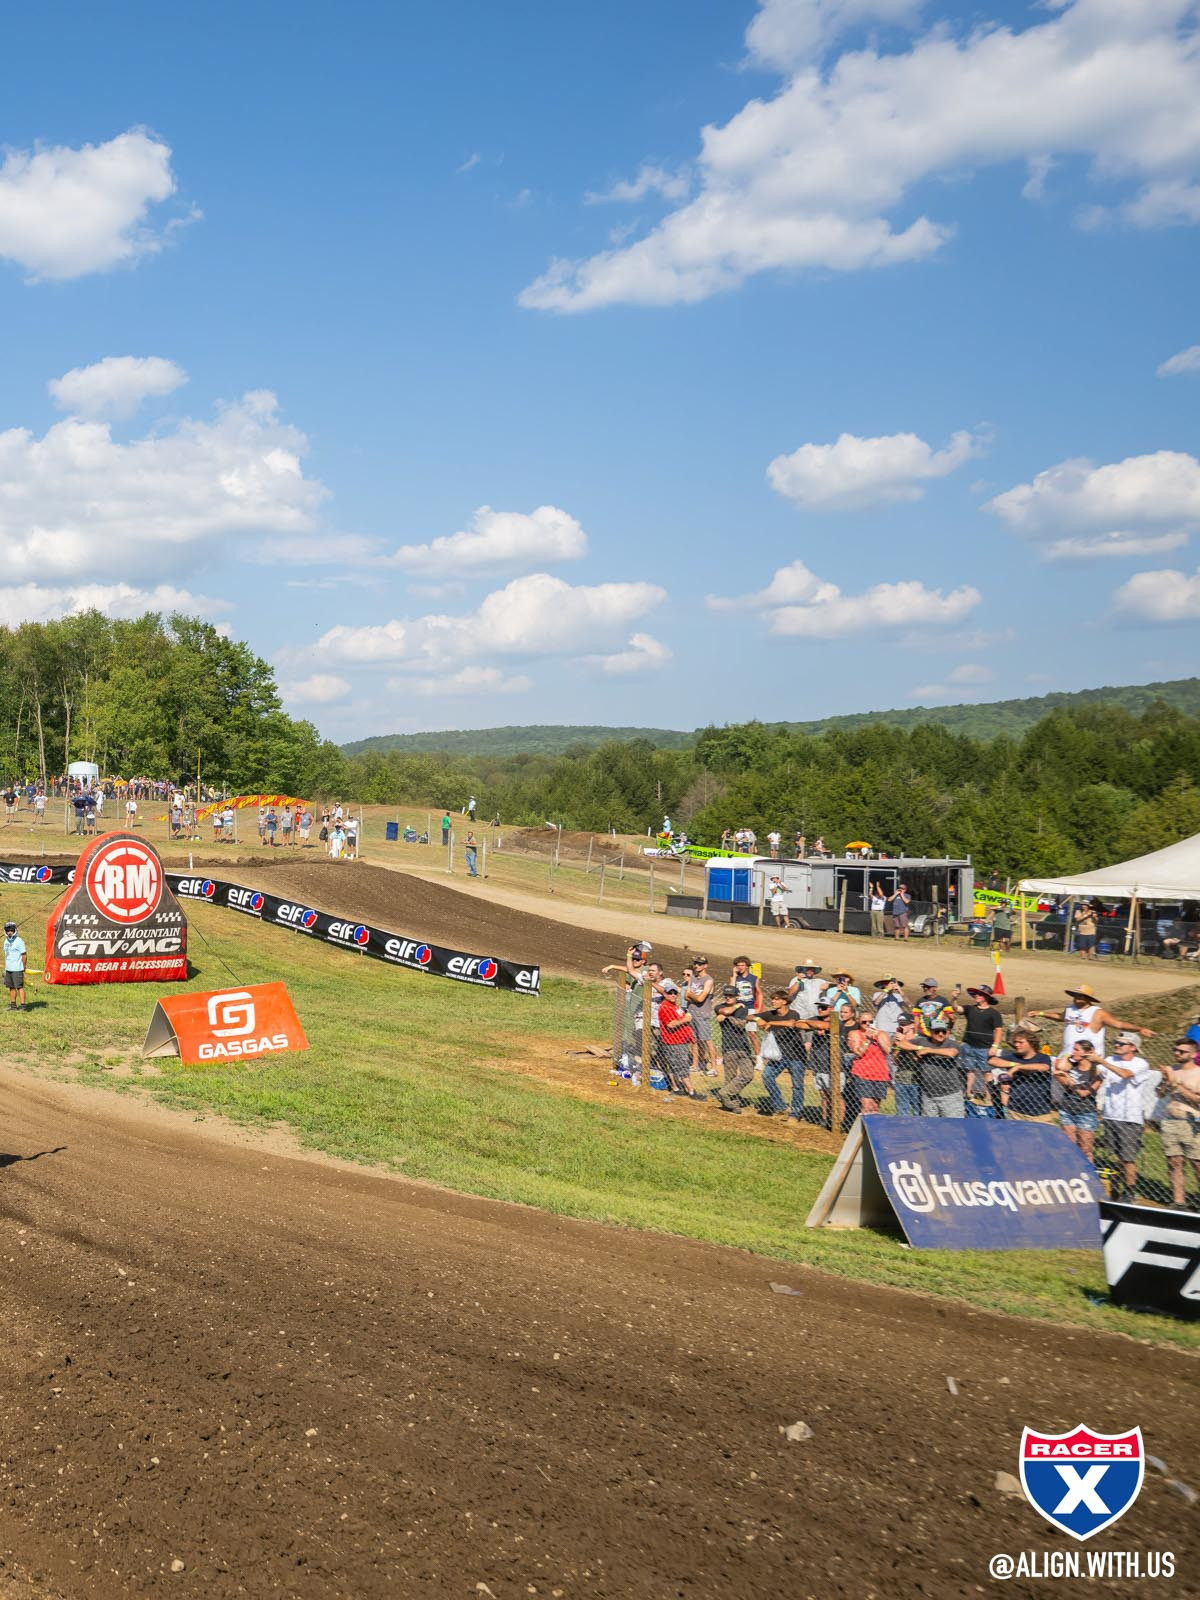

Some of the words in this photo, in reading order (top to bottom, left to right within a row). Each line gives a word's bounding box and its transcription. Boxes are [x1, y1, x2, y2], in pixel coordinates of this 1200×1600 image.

[8, 867, 36, 881] elf
[177, 879, 202, 895] elf
[228, 888, 253, 906] elf
[277, 904, 304, 922] elf
[328, 922, 355, 940] elf
[384, 938, 418, 959] elf
[95, 962, 119, 972] GEAR
[119, 962, 128, 971] &
[128, 958, 184, 970] ACCESSORIES
[447, 957, 479, 976] elf
[198, 1033, 289, 1060] GASGAS
[929, 1173, 1097, 1212] Husqvarna
